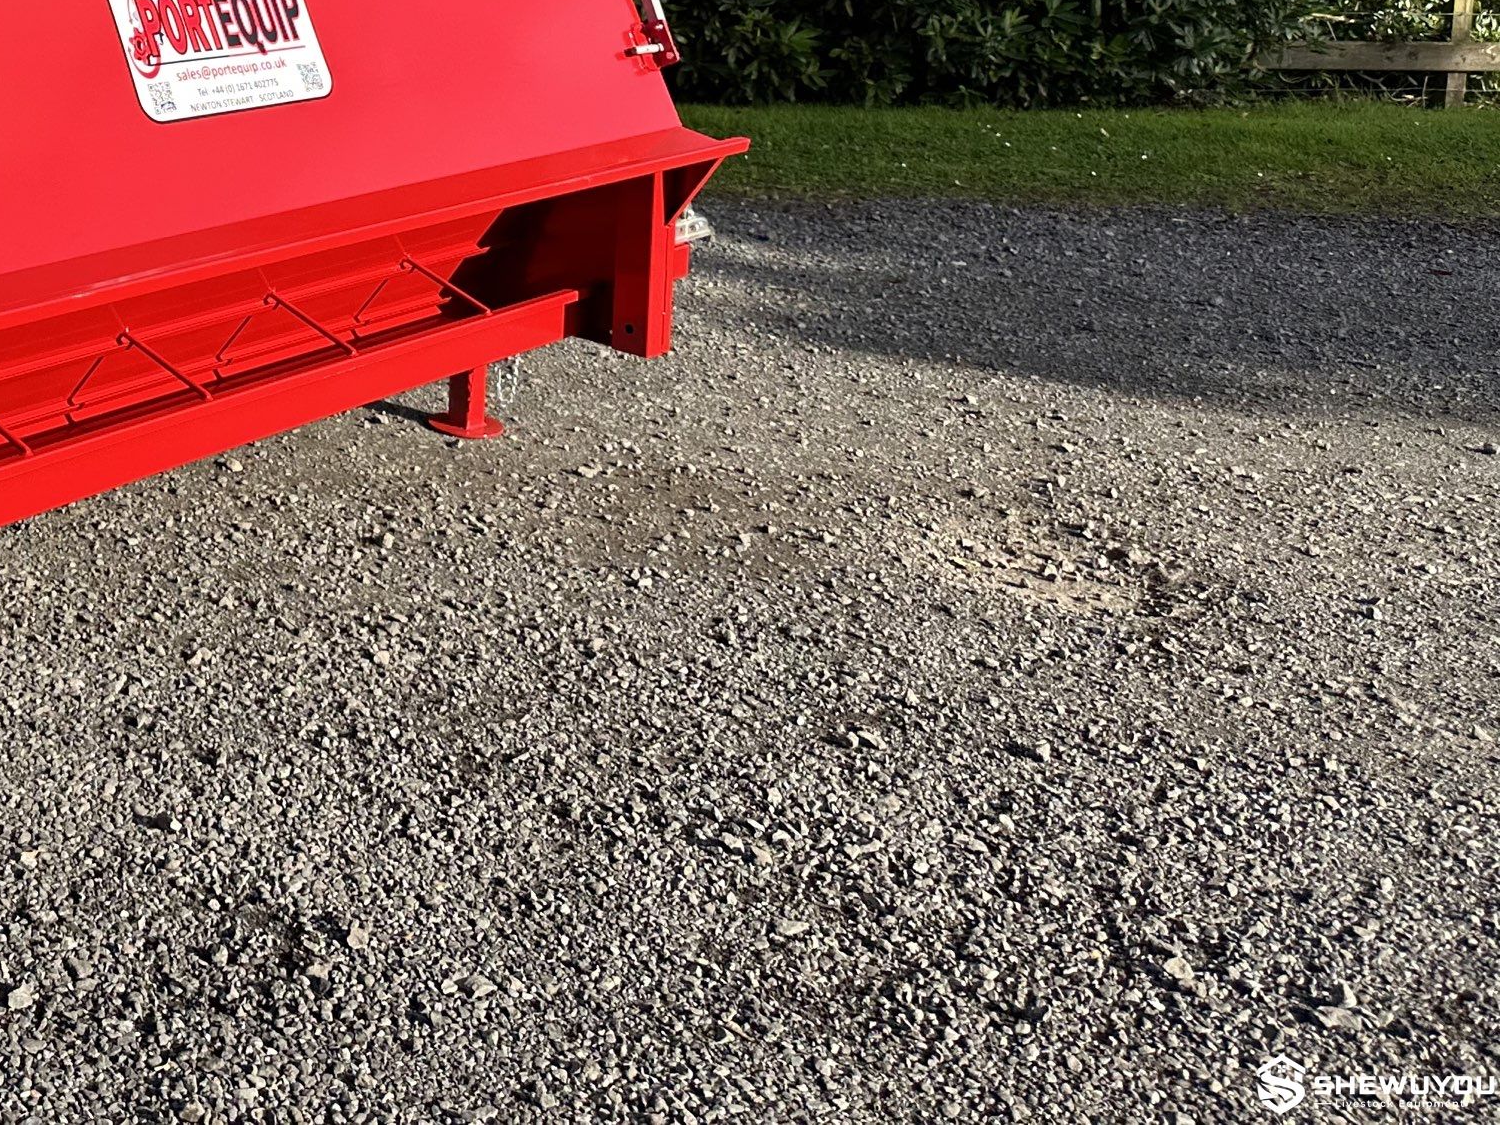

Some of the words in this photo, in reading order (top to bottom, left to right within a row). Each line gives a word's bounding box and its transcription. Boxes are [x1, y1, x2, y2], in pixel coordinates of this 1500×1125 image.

[176, 56, 287, 81] sales@portequip.co.uk
[212, 85, 224, 95] +44
[225, 83, 236, 95] (0)
[237, 81, 253, 92] 1671
[190, 100, 221, 113] NEWTON
[222, 95, 254, 108] STEWART
[258, 89, 294, 102] SCOTLAND
